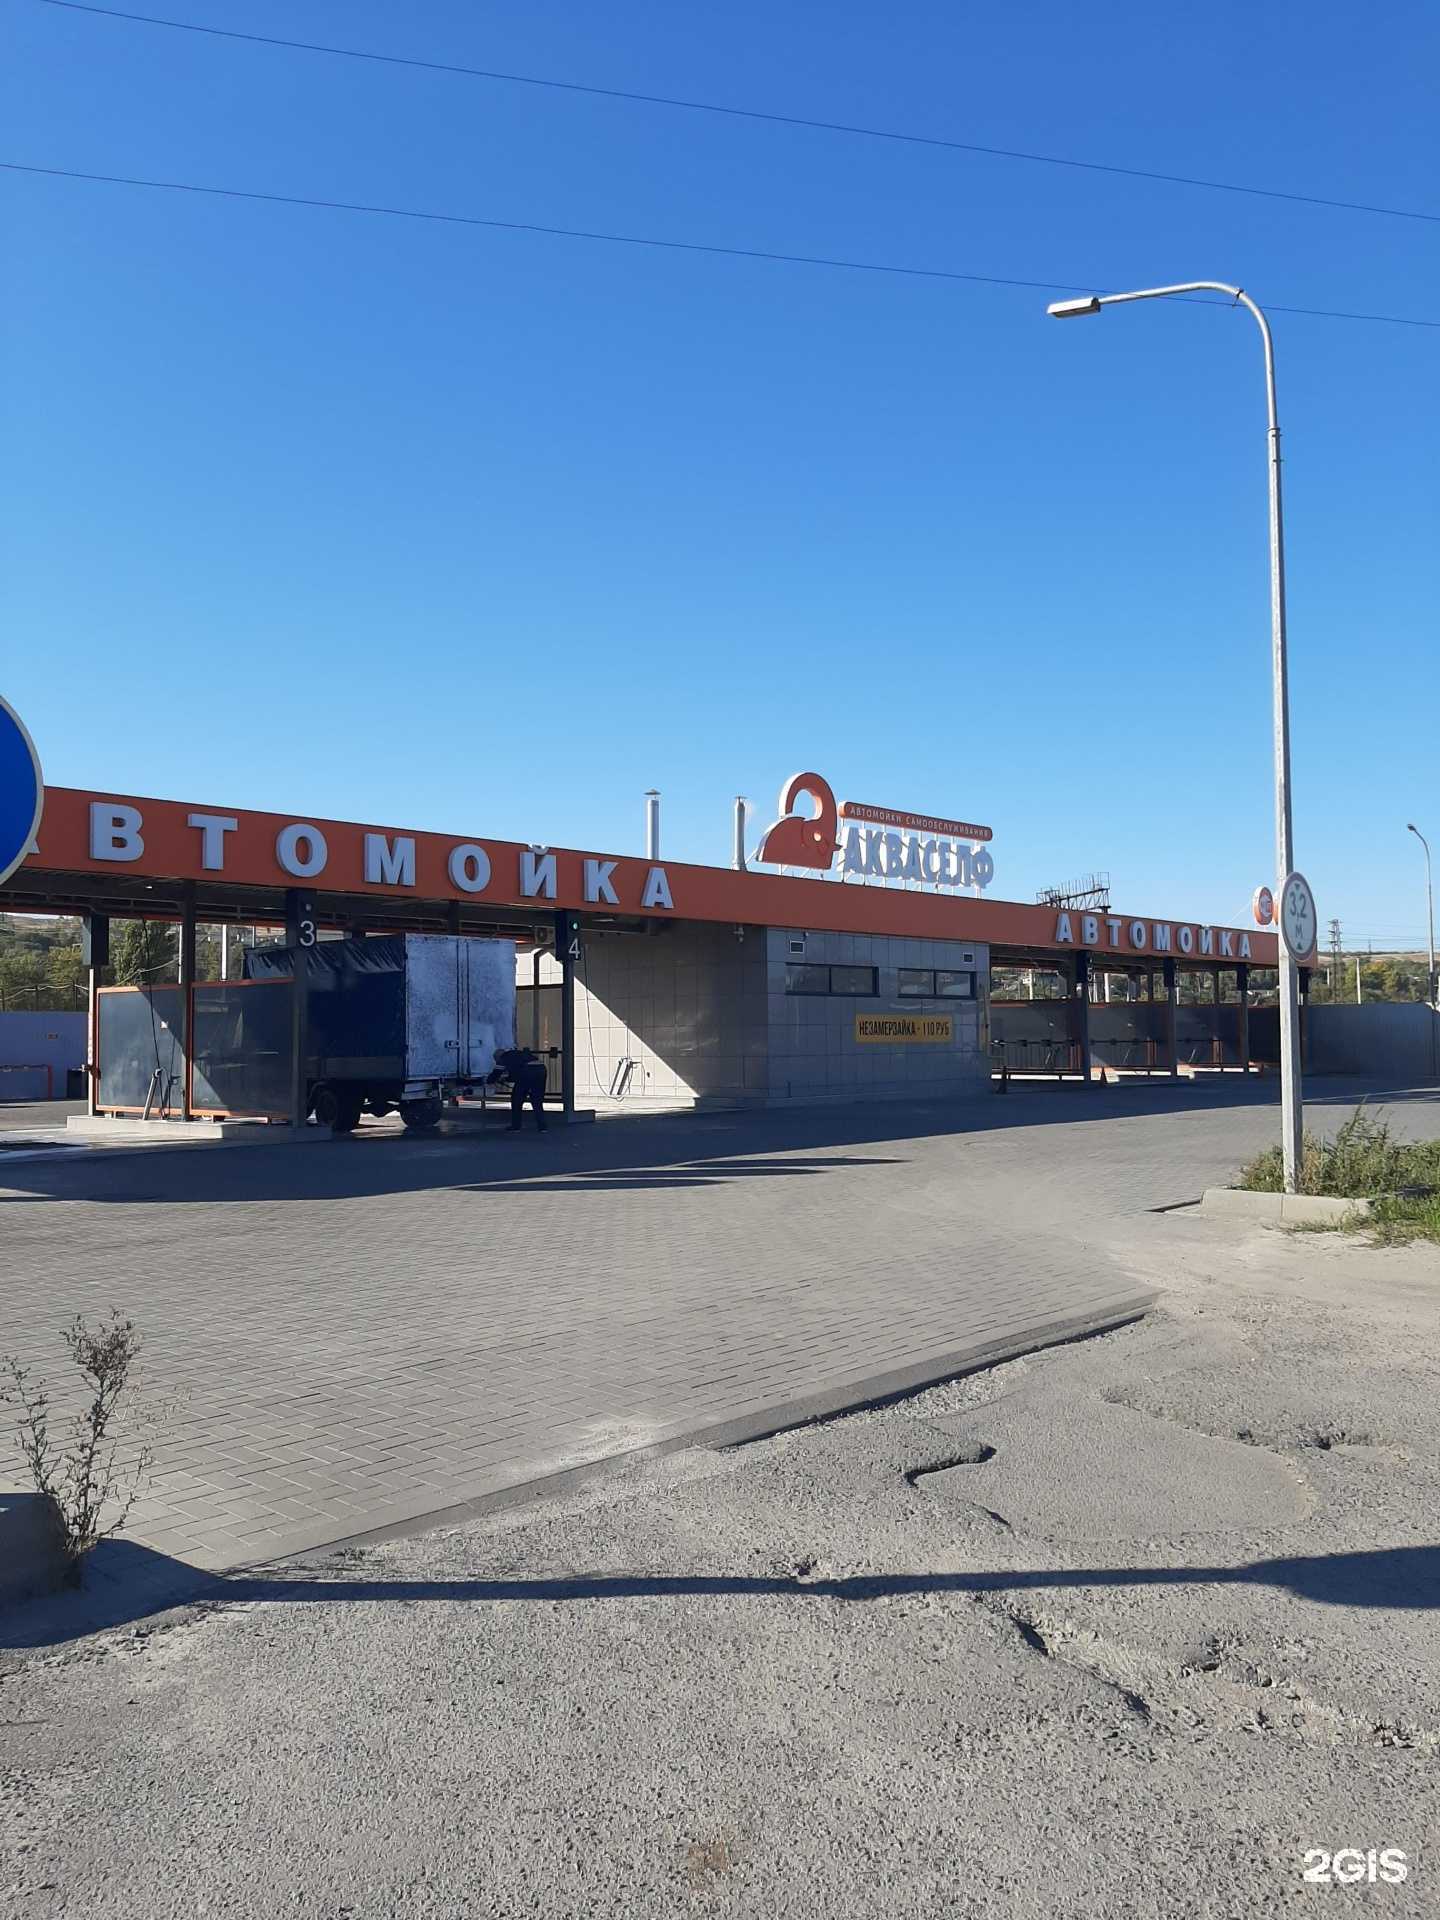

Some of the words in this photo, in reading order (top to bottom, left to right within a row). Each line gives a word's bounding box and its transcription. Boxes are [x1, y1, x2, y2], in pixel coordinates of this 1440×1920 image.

[850, 806, 902, 823] АВТОМОЙКИ
[905, 816, 989, 837] САМООБСЛУЖИВАНИЯ
[27, 801, 675, 909] ВТОМОЙКА
[843, 826, 994, 889] АКВАСЕЛФ
[300, 920, 315, 946] 3
[1055, 912, 1252, 958] АВТОМОЙКА
[568, 937, 581, 960] 4
[1087, 967, 1093, 982] 5
[859, 1019, 915, 1036] НЕЗАМЕРЗАЙКА
